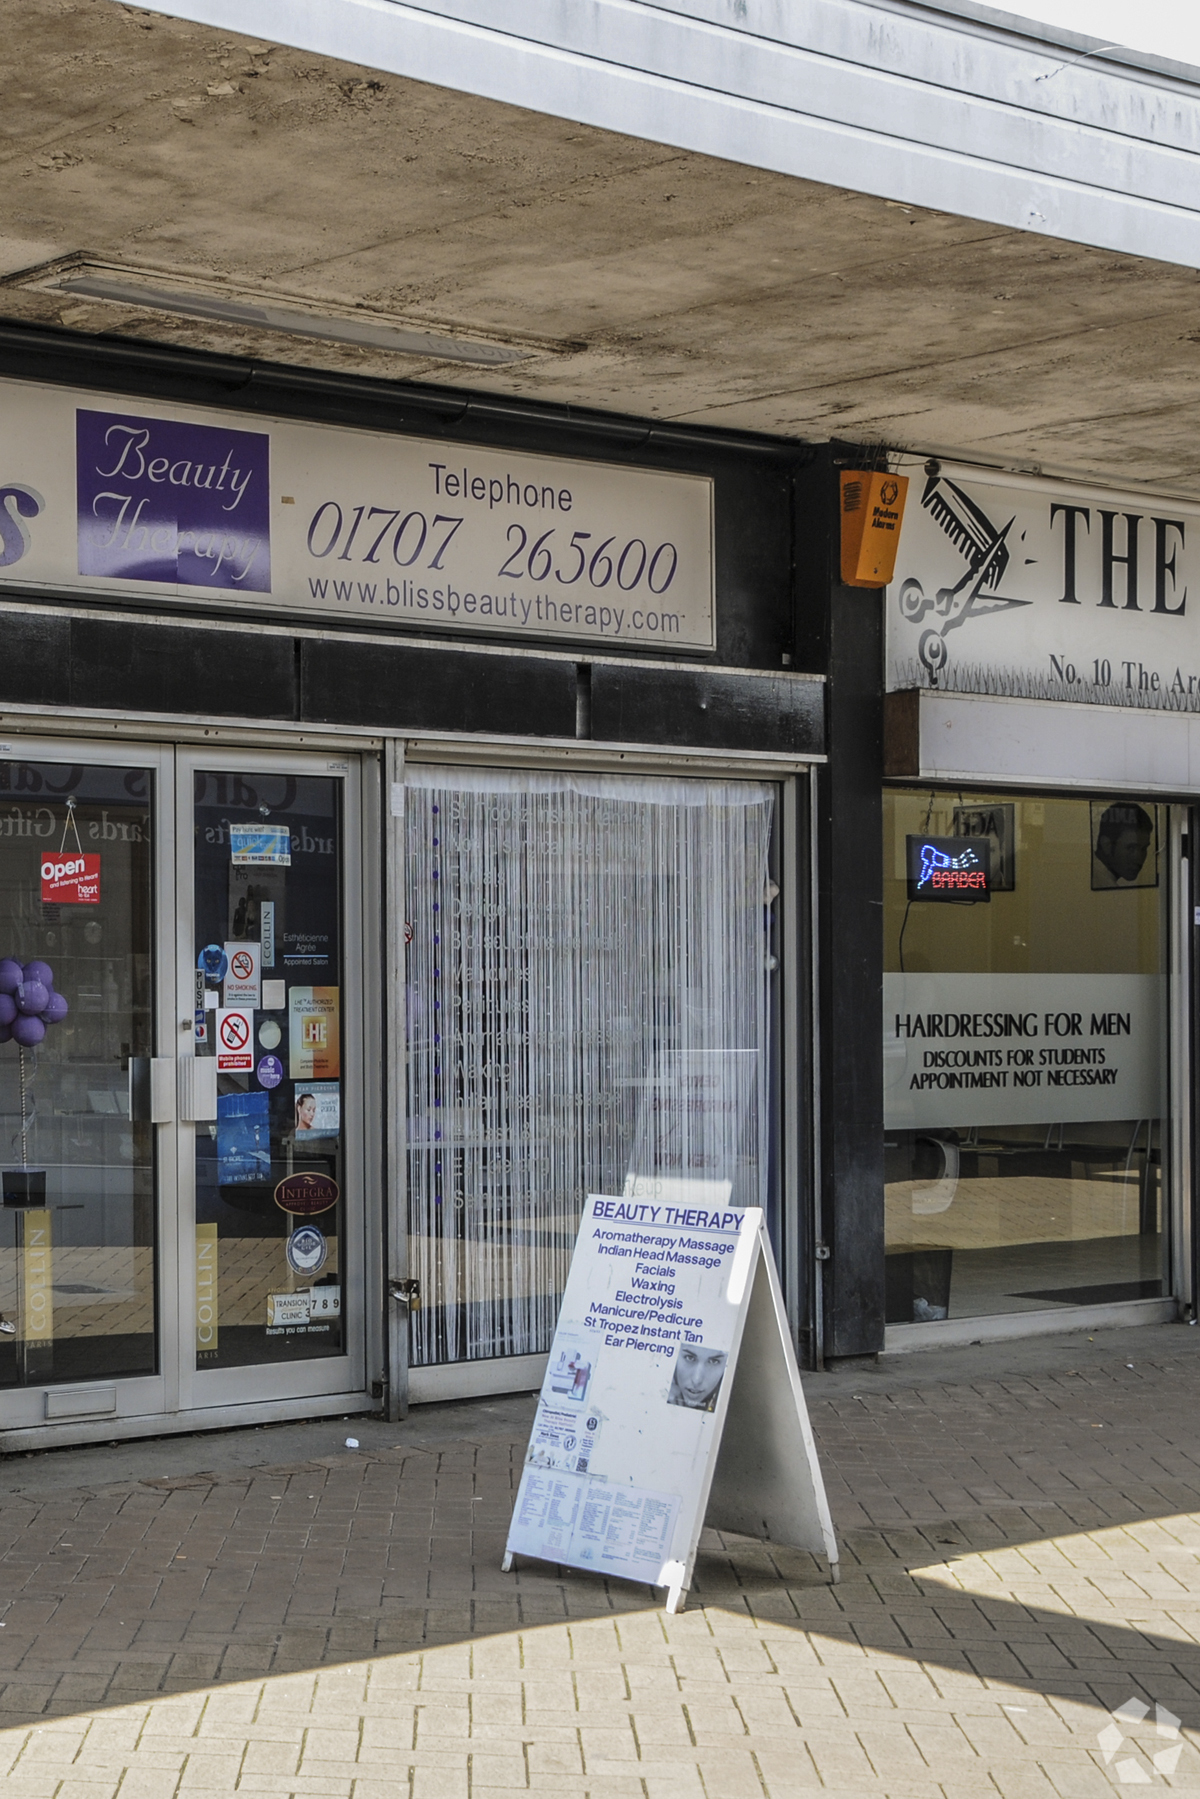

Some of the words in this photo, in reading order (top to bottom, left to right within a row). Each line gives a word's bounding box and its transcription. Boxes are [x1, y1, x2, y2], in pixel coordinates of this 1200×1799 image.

[95, 425, 253, 511] Beauty
[428, 463, 573, 513] Telephone
[871, 517, 896, 530] Alarms
[872, 506, 899, 520] Modern
[92, 492, 263, 582] Therapy
[306, 502, 465, 571] 01707
[498, 524, 679, 595] 265600
[1050, 502, 1188, 617] THE
[307, 576, 681, 635] www.blissbeautytherapy.com
[1048, 653, 1082, 686] No.
[1091, 658, 1113, 688] 10
[1121, 661, 1162, 692] The
[1170, 666, 1200, 697] Ar
[40, 858, 85, 882] Open
[931, 871, 987, 889] BARBER
[263, 910, 272, 960] COLLIN
[283, 958, 311, 966] Appointed
[312, 958, 329, 966] Salon
[302, 1022, 327, 1043] LHE
[895, 1013, 1038, 1038] HAIRDRESSING
[1044, 1012, 1083, 1037] FOR
[1089, 1012, 1132, 1036] MEN
[923, 1049, 1003, 1068] DISCOUNTS
[1007, 1049, 1035, 1066] FOR
[1038, 1048, 1106, 1066] STUDENTS
[909, 1071, 1009, 1090] APPOINTMENT
[1013, 1070, 1043, 1087] NOT
[1047, 1069, 1119, 1086] NECESSARY
[592, 1201, 662, 1222] BEAUTY
[665, 1207, 745, 1231] THERAPY
[592, 1228, 678, 1250] Aromatherapy
[678, 1237, 735, 1255] Massage
[598, 1243, 633, 1258] Indian
[633, 1247, 664, 1262] Head
[665, 1251, 722, 1269] Massage
[29, 1228, 46, 1331] COLLIN
[634, 1263, 677, 1278] Facials
[198, 1243, 213, 1343] COLLIN
[631, 1277, 676, 1296] Waxing
[311, 1300, 317, 1310] 7
[322, 1299, 328, 1310] 8
[333, 1298, 339, 1309] 9
[615, 1290, 684, 1310] Electrolysis
[281, 1312, 303, 1320] CLINIC
[589, 1302, 703, 1328] Manicure/Pedicure
[266, 1326, 285, 1335] Results
[286, 1327, 295, 1335] you
[583, 1316, 597, 1328] St
[599, 1318, 639, 1335] Tropez
[640, 1324, 682, 1341] Instant
[683, 1330, 704, 1344] Tan
[604, 1335, 625, 1348] Ear
[625, 1337, 675, 1358] Piercing
